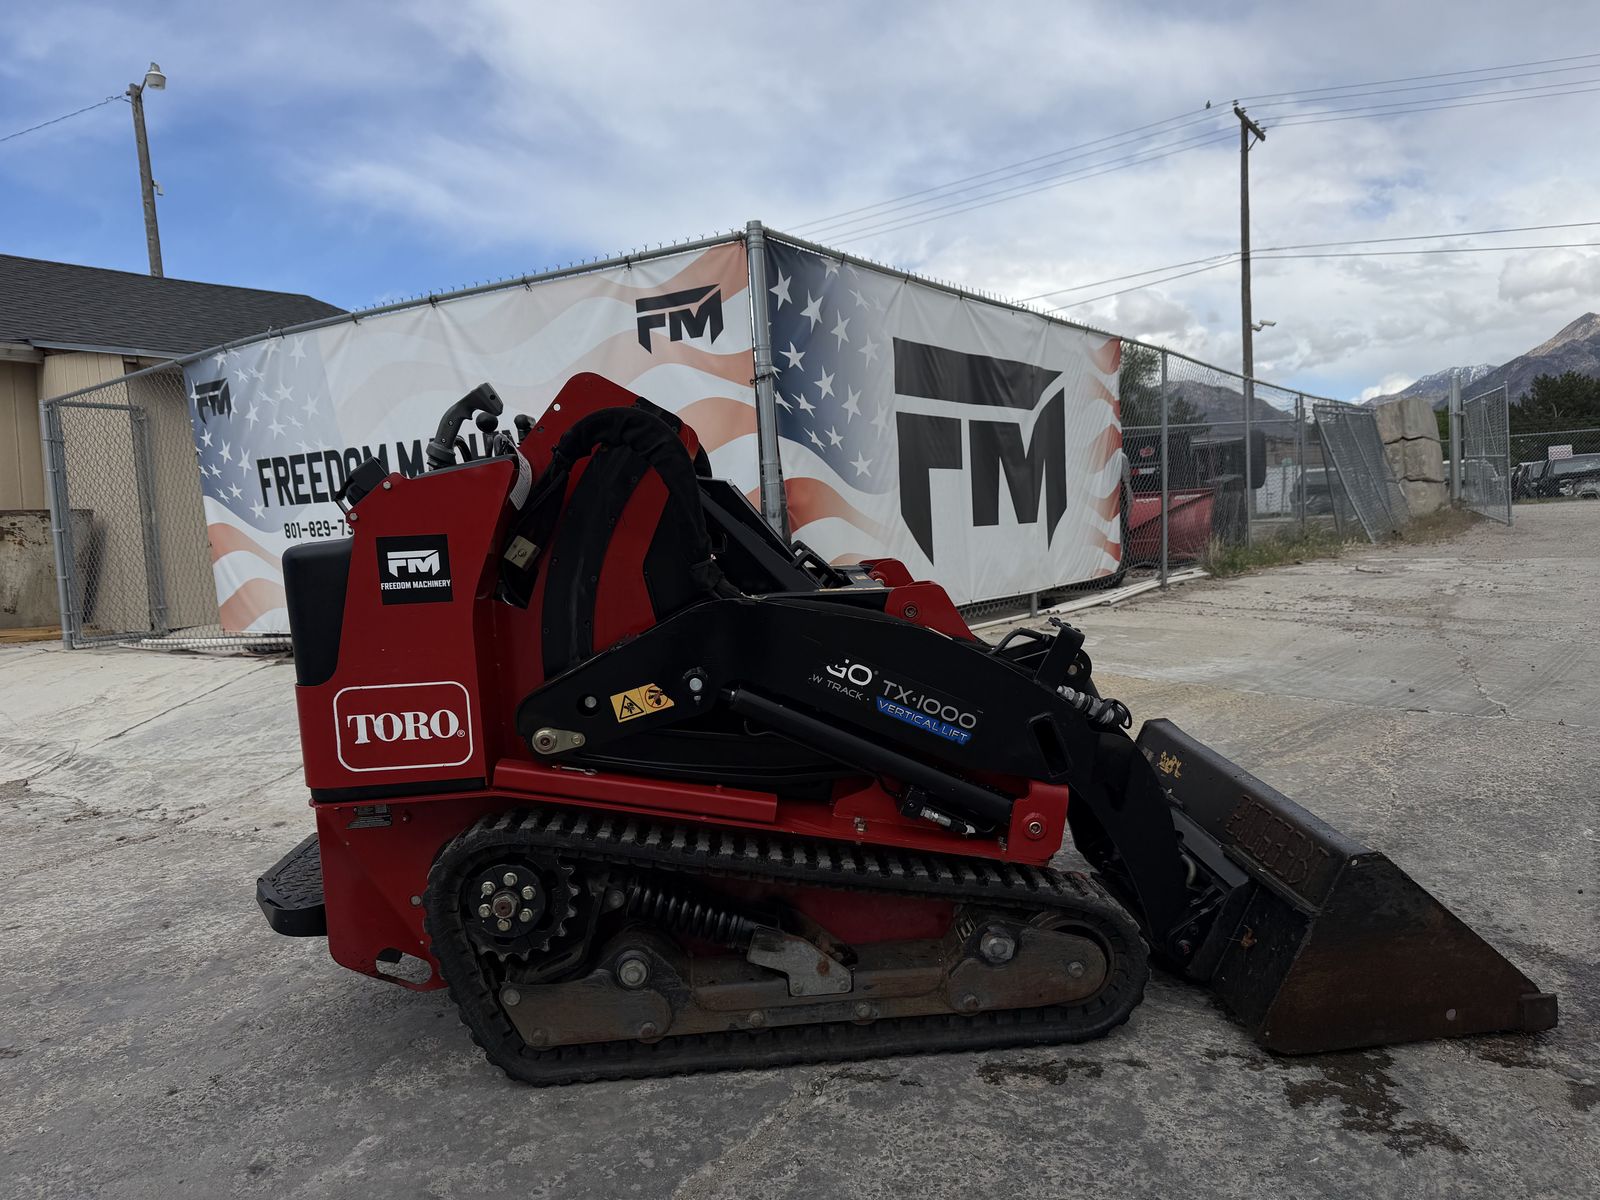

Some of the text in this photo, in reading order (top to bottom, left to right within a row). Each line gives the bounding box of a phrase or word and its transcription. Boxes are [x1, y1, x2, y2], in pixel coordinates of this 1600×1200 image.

[635, 284, 723, 355] FM
[194, 377, 232, 425] FM
[893, 337, 1067, 567] FM
[387, 549, 440, 577] FM
[381, 580, 451, 590] FREEDOM MACHINERY
[827, 679, 863, 701] TRACK
[347, 709, 459, 744] TORO
[879, 700, 968, 742] VERTICAL LIFT
